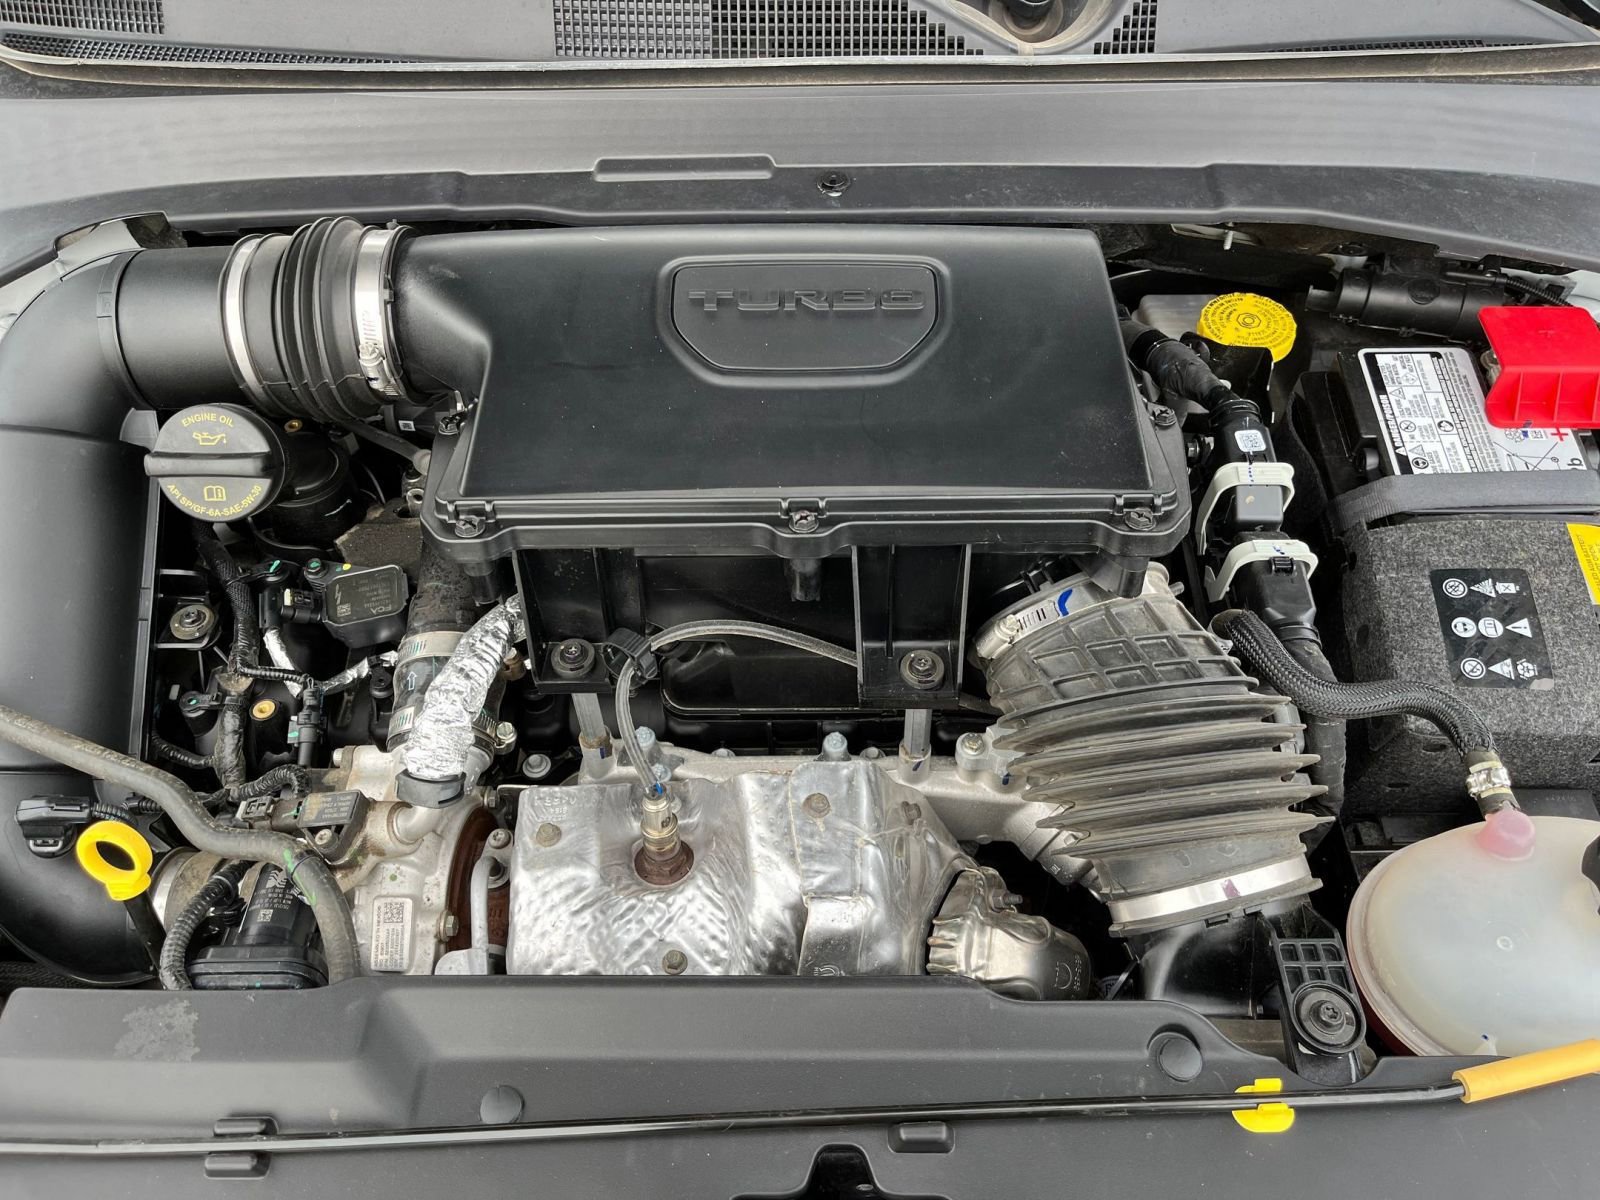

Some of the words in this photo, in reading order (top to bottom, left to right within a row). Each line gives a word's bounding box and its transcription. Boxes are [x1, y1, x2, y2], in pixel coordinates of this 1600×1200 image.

[688, 288, 926, 312] TURBO
[181, 412, 217, 428] ENGINE
[219, 415, 235, 428] OIL
[166, 484, 182, 500] API
[370, 604, 392, 616] FCA
